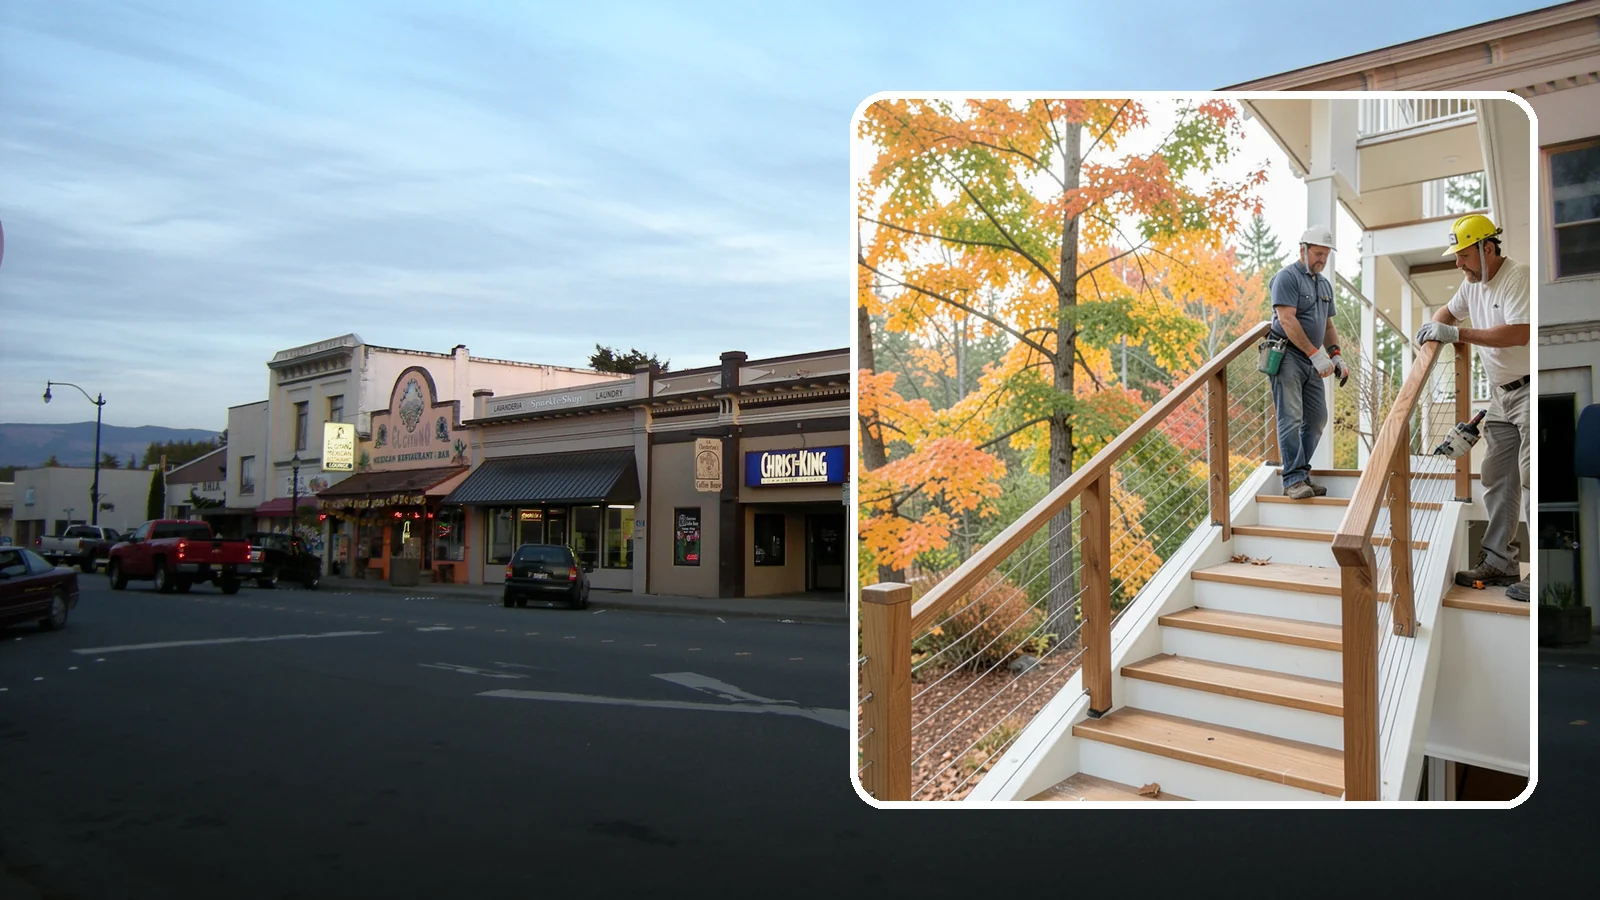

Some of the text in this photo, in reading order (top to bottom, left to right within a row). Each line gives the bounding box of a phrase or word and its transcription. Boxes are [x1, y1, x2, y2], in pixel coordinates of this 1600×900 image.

[595, 389, 623, 400] LAUNDRY
[493, 402, 522, 412] LAVANDERIA
[530, 395, 582, 409] Sparkle Shop
[373, 454, 396, 464] MEXICAN
[397, 451, 433, 462] RESTAURANT
[438, 449, 450, 459] BAR
[697, 481, 721, 489] Coffee House
